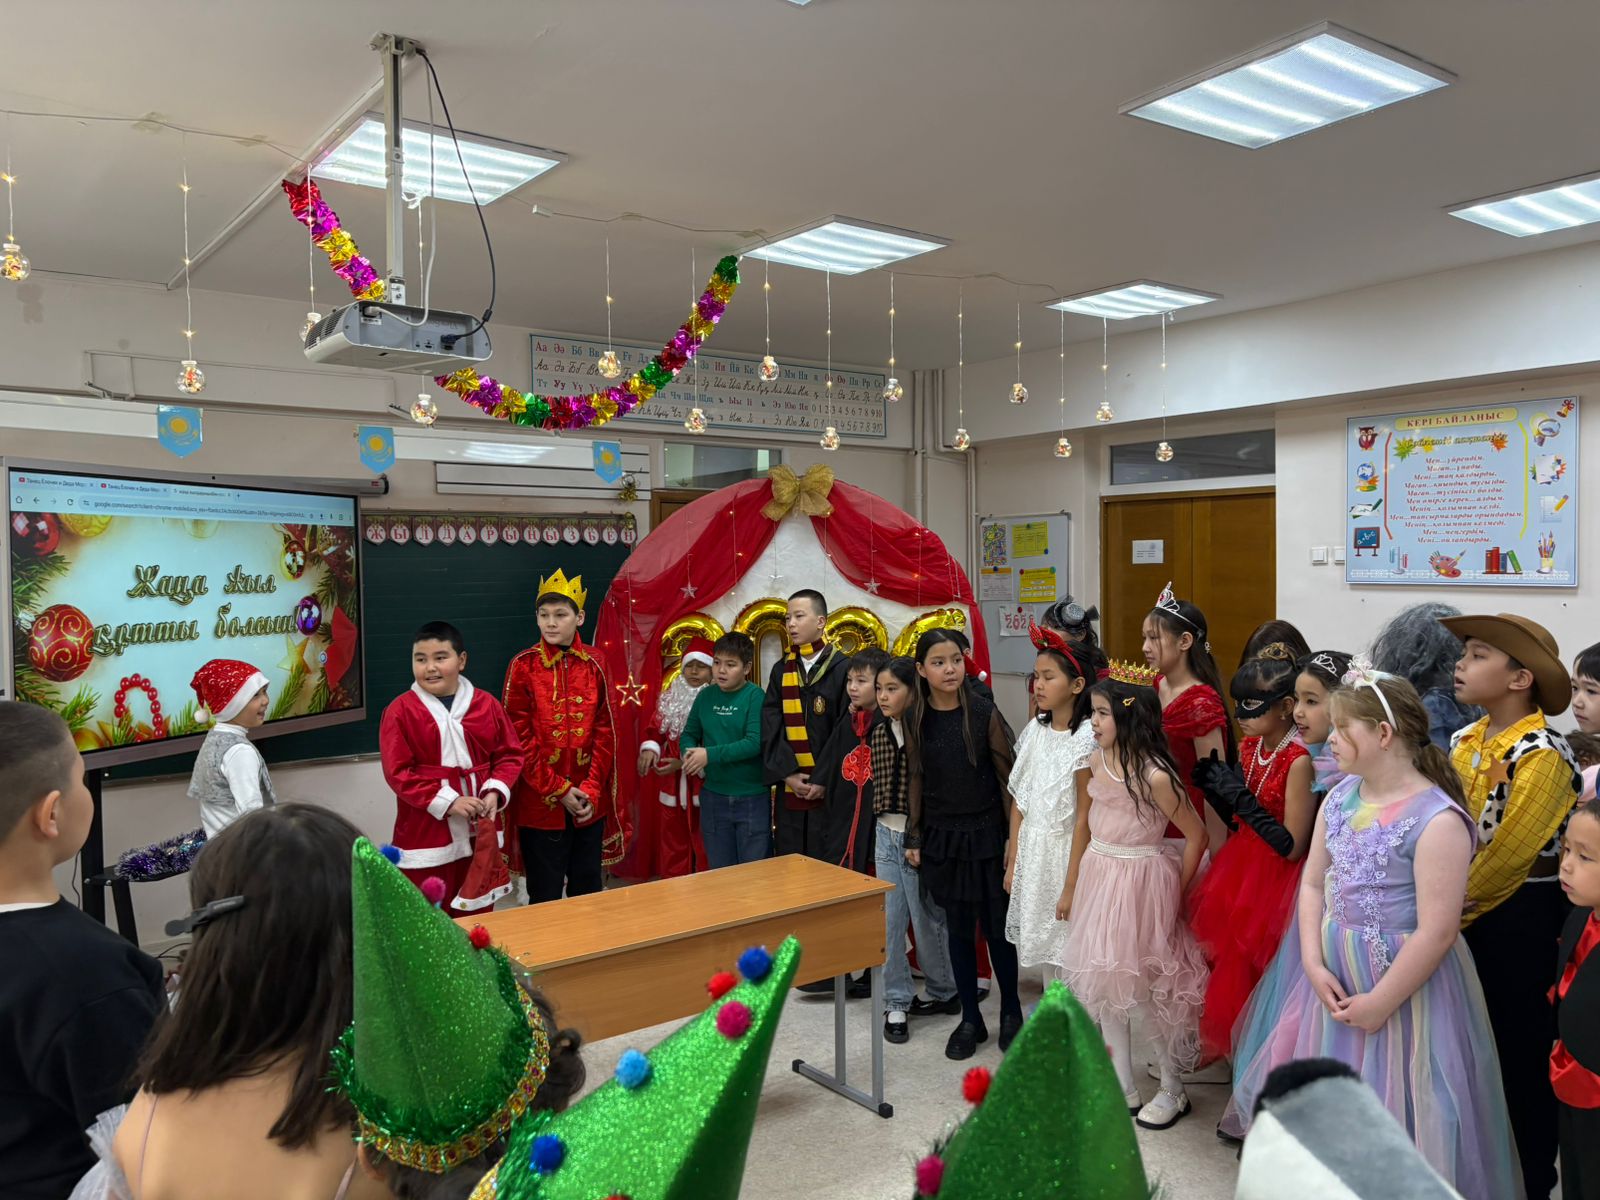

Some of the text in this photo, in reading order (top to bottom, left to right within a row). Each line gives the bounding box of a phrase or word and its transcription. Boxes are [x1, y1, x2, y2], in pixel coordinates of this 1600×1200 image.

[536, 341, 548, 353] Аа
[553, 343, 565, 354] Әә
[571, 345, 582, 355] Бб
[534, 359, 548, 371] Аа
[537, 379, 548, 388] Тт
[553, 379, 566, 390] Уу
[1407, 411, 1504, 428] КЕРІ БАЙЛАНЫС
[126, 564, 209, 606] Жаңа
